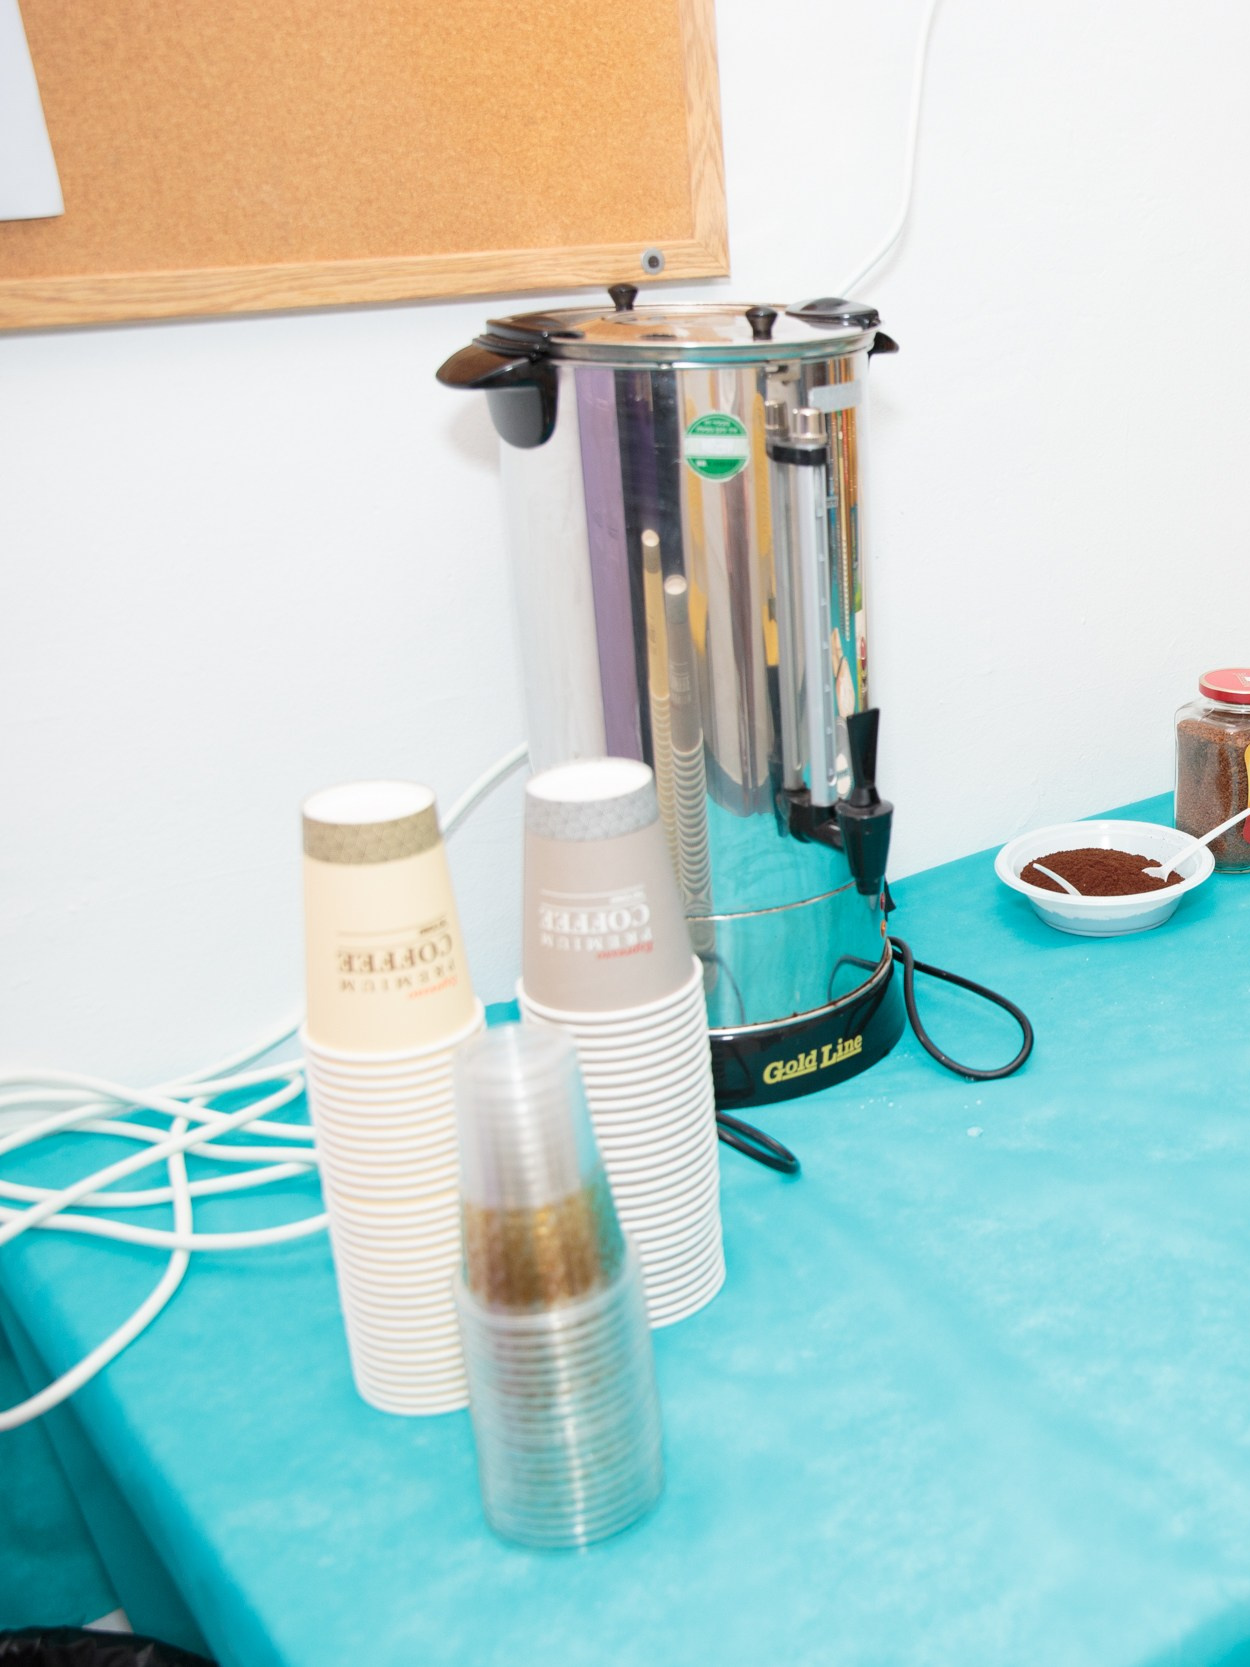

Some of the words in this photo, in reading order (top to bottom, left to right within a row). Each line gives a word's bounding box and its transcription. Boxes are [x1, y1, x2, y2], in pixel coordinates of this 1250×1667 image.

[537, 902, 651, 935] COFFEE
[337, 933, 453, 974] COFFEE
[763, 1049, 818, 1085] Gold
[820, 1035, 863, 1069] Line
